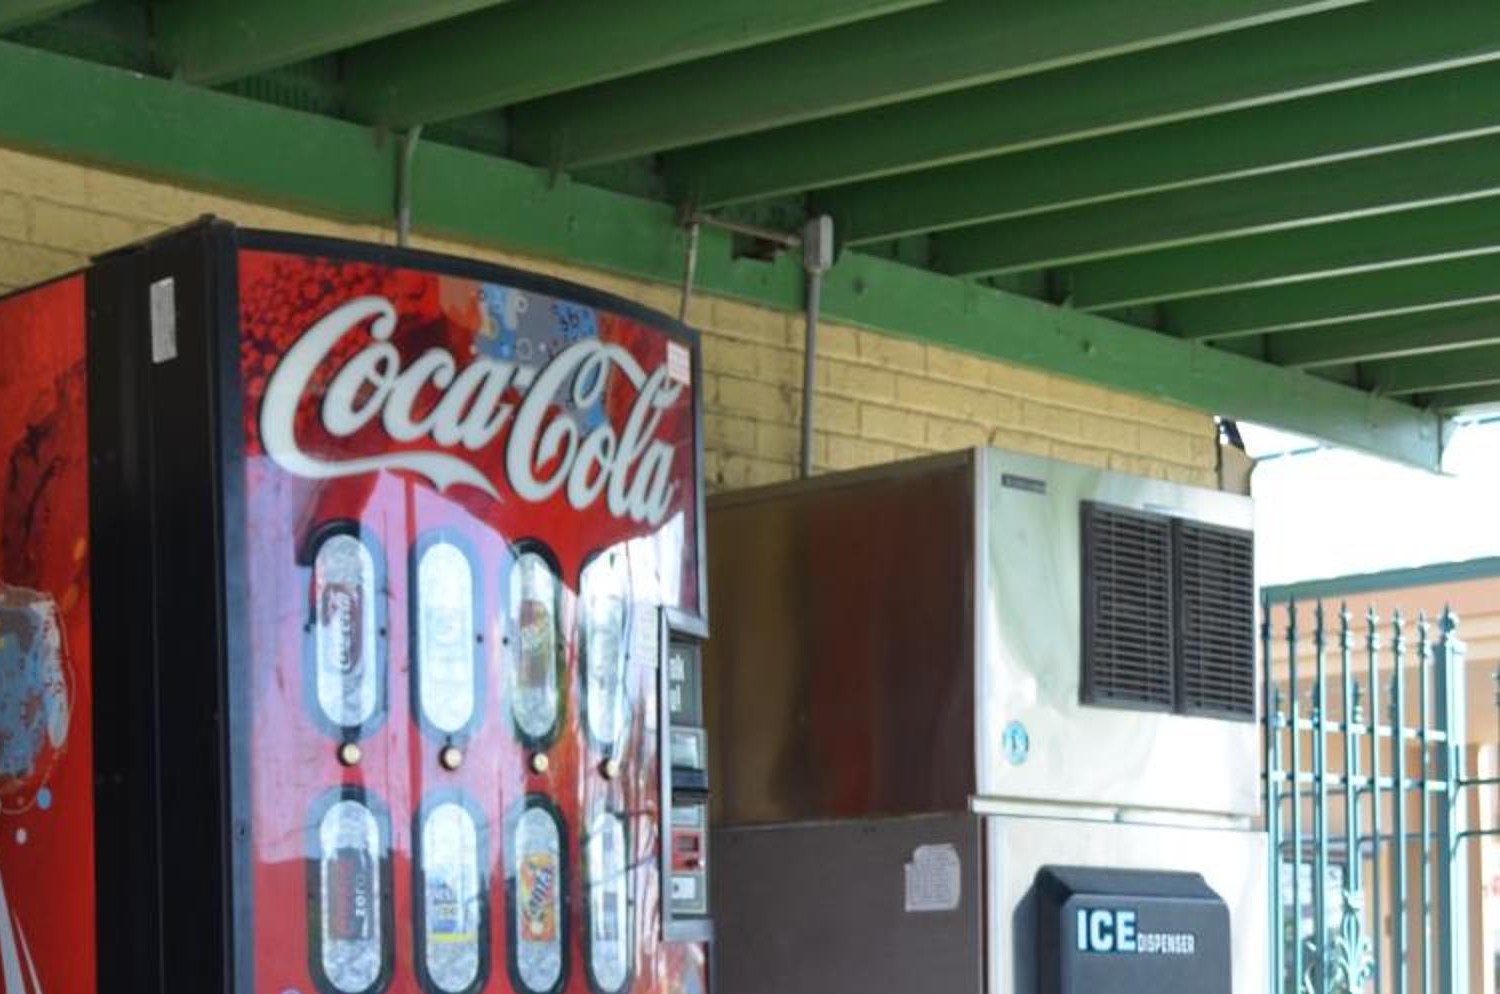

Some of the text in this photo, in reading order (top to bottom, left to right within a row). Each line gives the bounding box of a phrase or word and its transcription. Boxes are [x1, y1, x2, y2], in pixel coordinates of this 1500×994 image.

[260, 296, 684, 524] Coca-Cola
[1077, 908, 1195, 954] ICE DISPENSER
